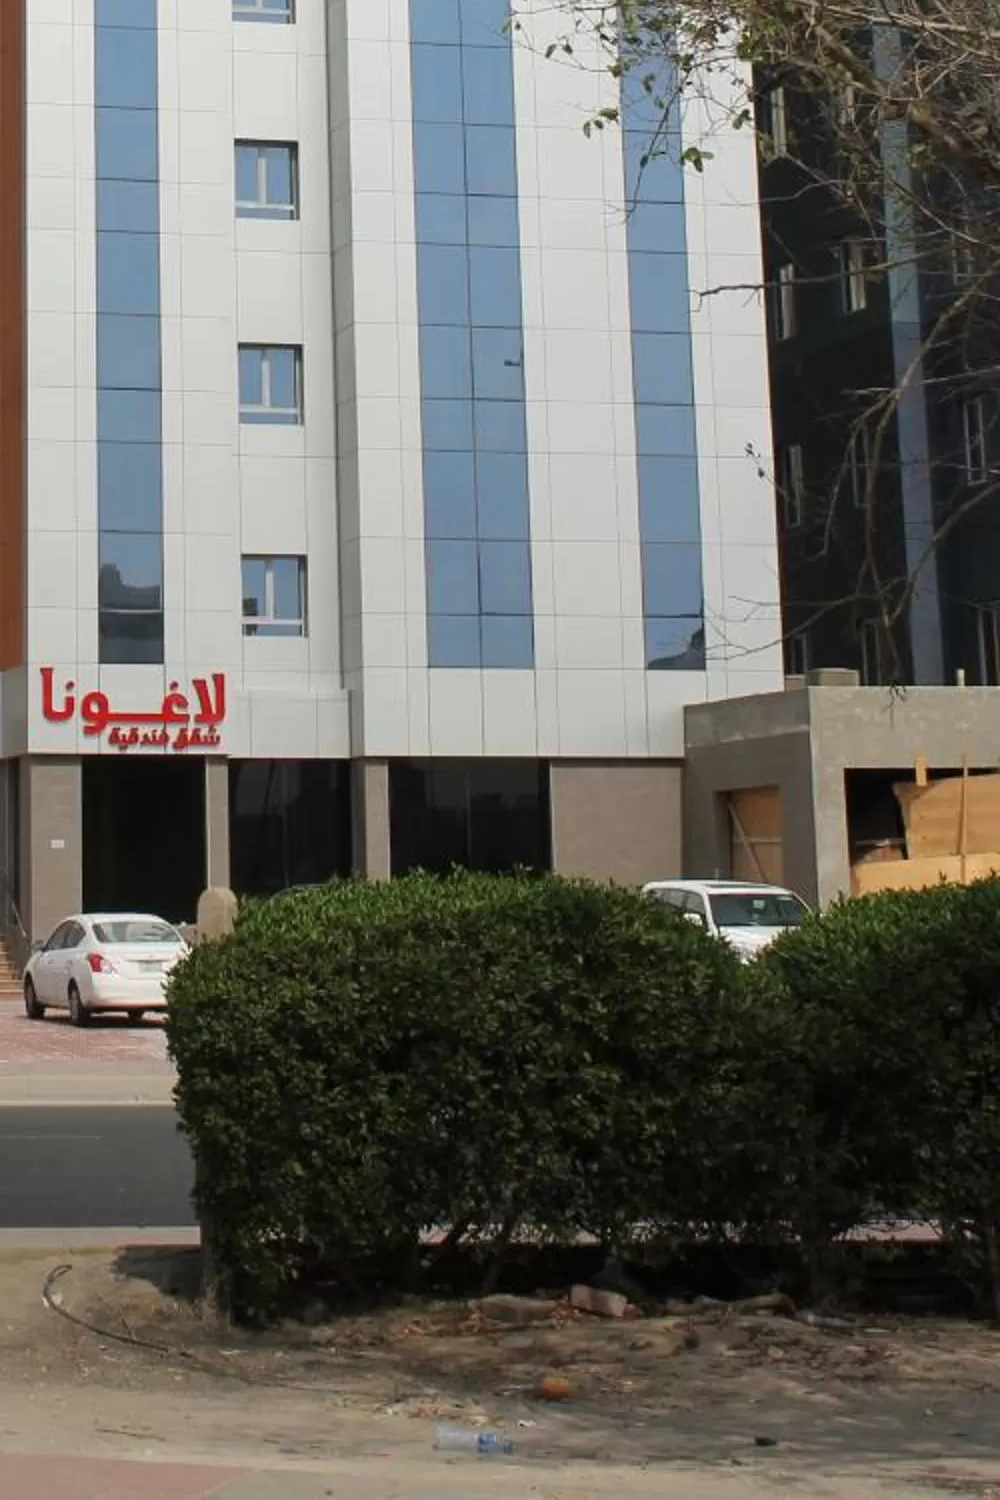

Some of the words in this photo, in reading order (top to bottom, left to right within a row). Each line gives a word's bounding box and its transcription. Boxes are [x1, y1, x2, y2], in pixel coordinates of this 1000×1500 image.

[40, 667, 225, 736] لاغونا
[108, 727, 169, 751] فندقية
[172, 724, 220, 750] شقق
